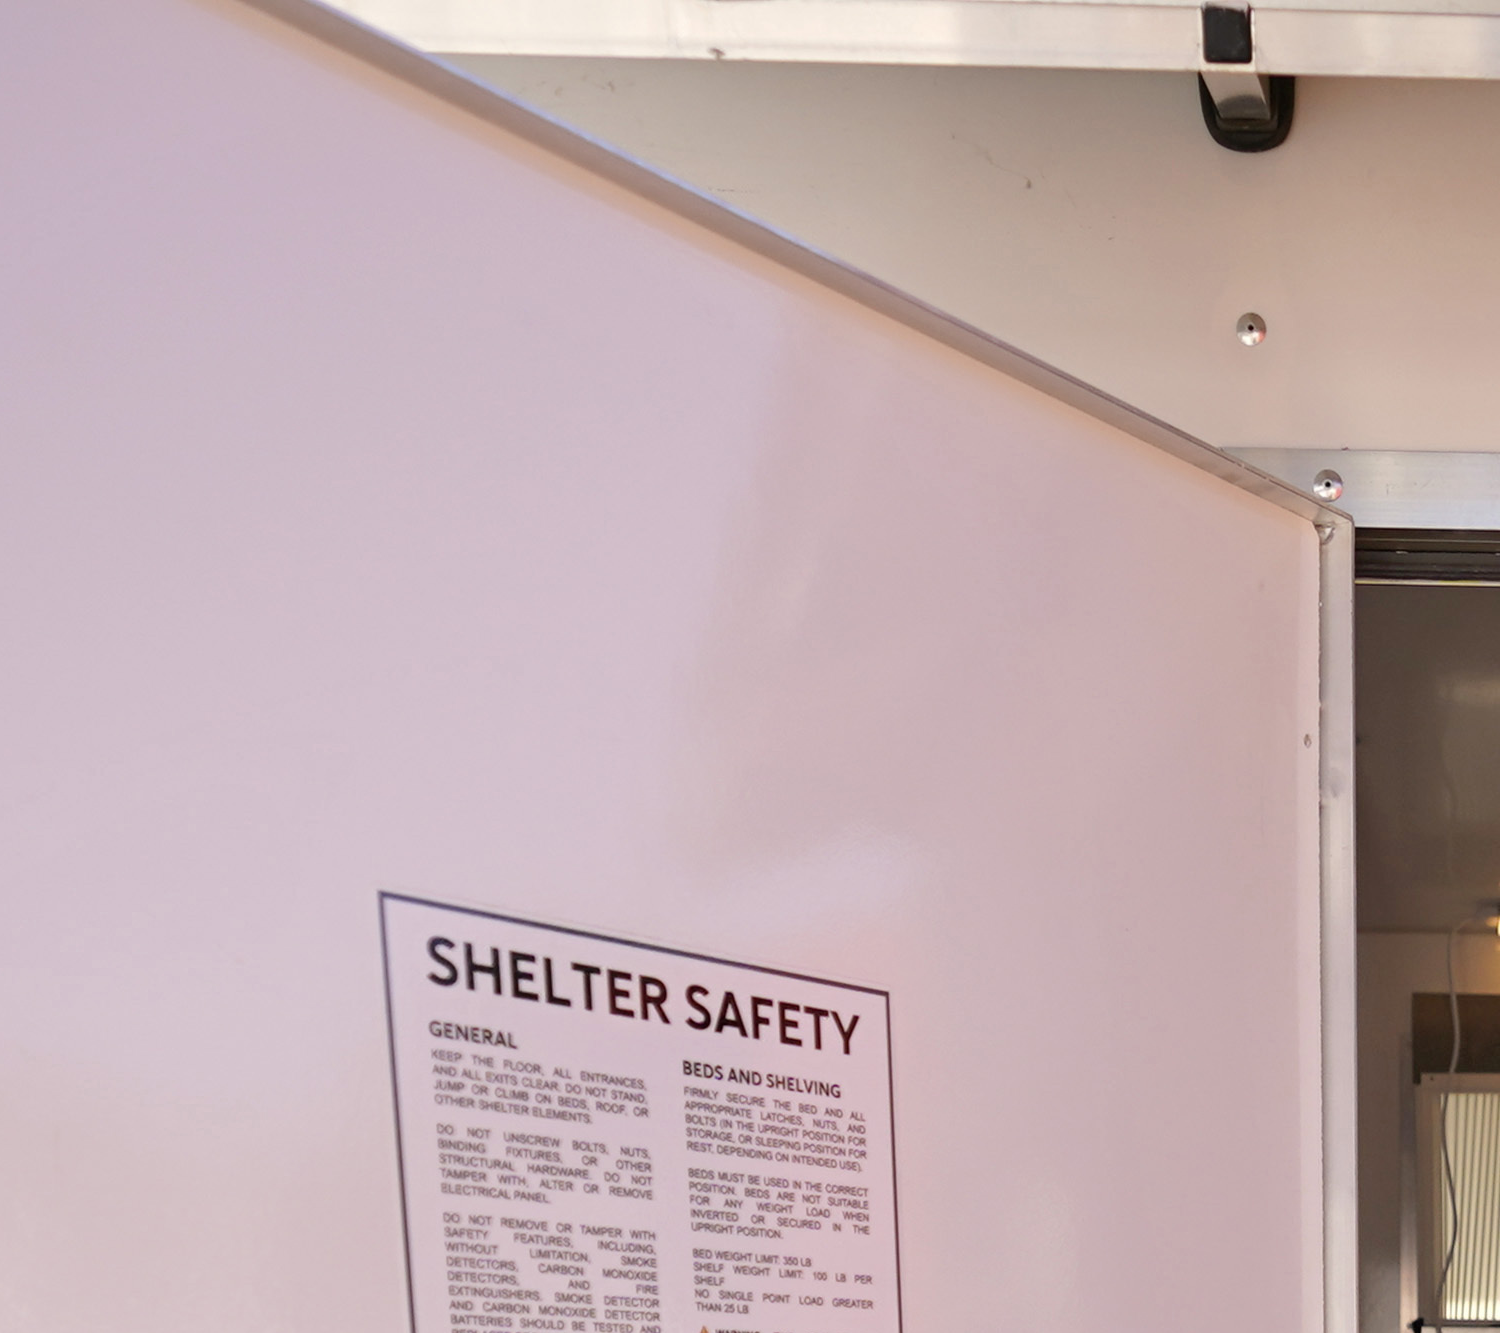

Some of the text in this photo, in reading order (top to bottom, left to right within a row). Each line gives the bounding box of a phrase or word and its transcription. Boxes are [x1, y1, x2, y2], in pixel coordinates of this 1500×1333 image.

[426, 936, 860, 1055] SHELTER SAFETY
[427, 1019, 518, 1050] GENERAL
[430, 1047, 464, 1064] KEEP
[471, 1054, 495, 1068] THE
[552, 1066, 572, 1080] ALL
[681, 1058, 842, 1100] BEDS AND SHELVING
[682, 1085, 865, 1122] FIRMLY SECURE THE BED AND ALL
[691, 1247, 714, 1260] BED
[713, 1249, 753, 1263] WEIGHT
[782, 1255, 799, 1267] 350
[799, 1257, 813, 1268] LB
[692, 1261, 725, 1274] SHELF
[732, 1264, 771, 1277] WEIGHT
[812, 1270, 828, 1282] 100
[834, 1272, 847, 1283] LB
[853, 1274, 873, 1285] PER
[692, 1274, 726, 1287] SHELF
[693, 1287, 874, 1310] NO SINGLE POINT LOAD GREATER
[695, 1301, 750, 1314] THAN 25 LB
